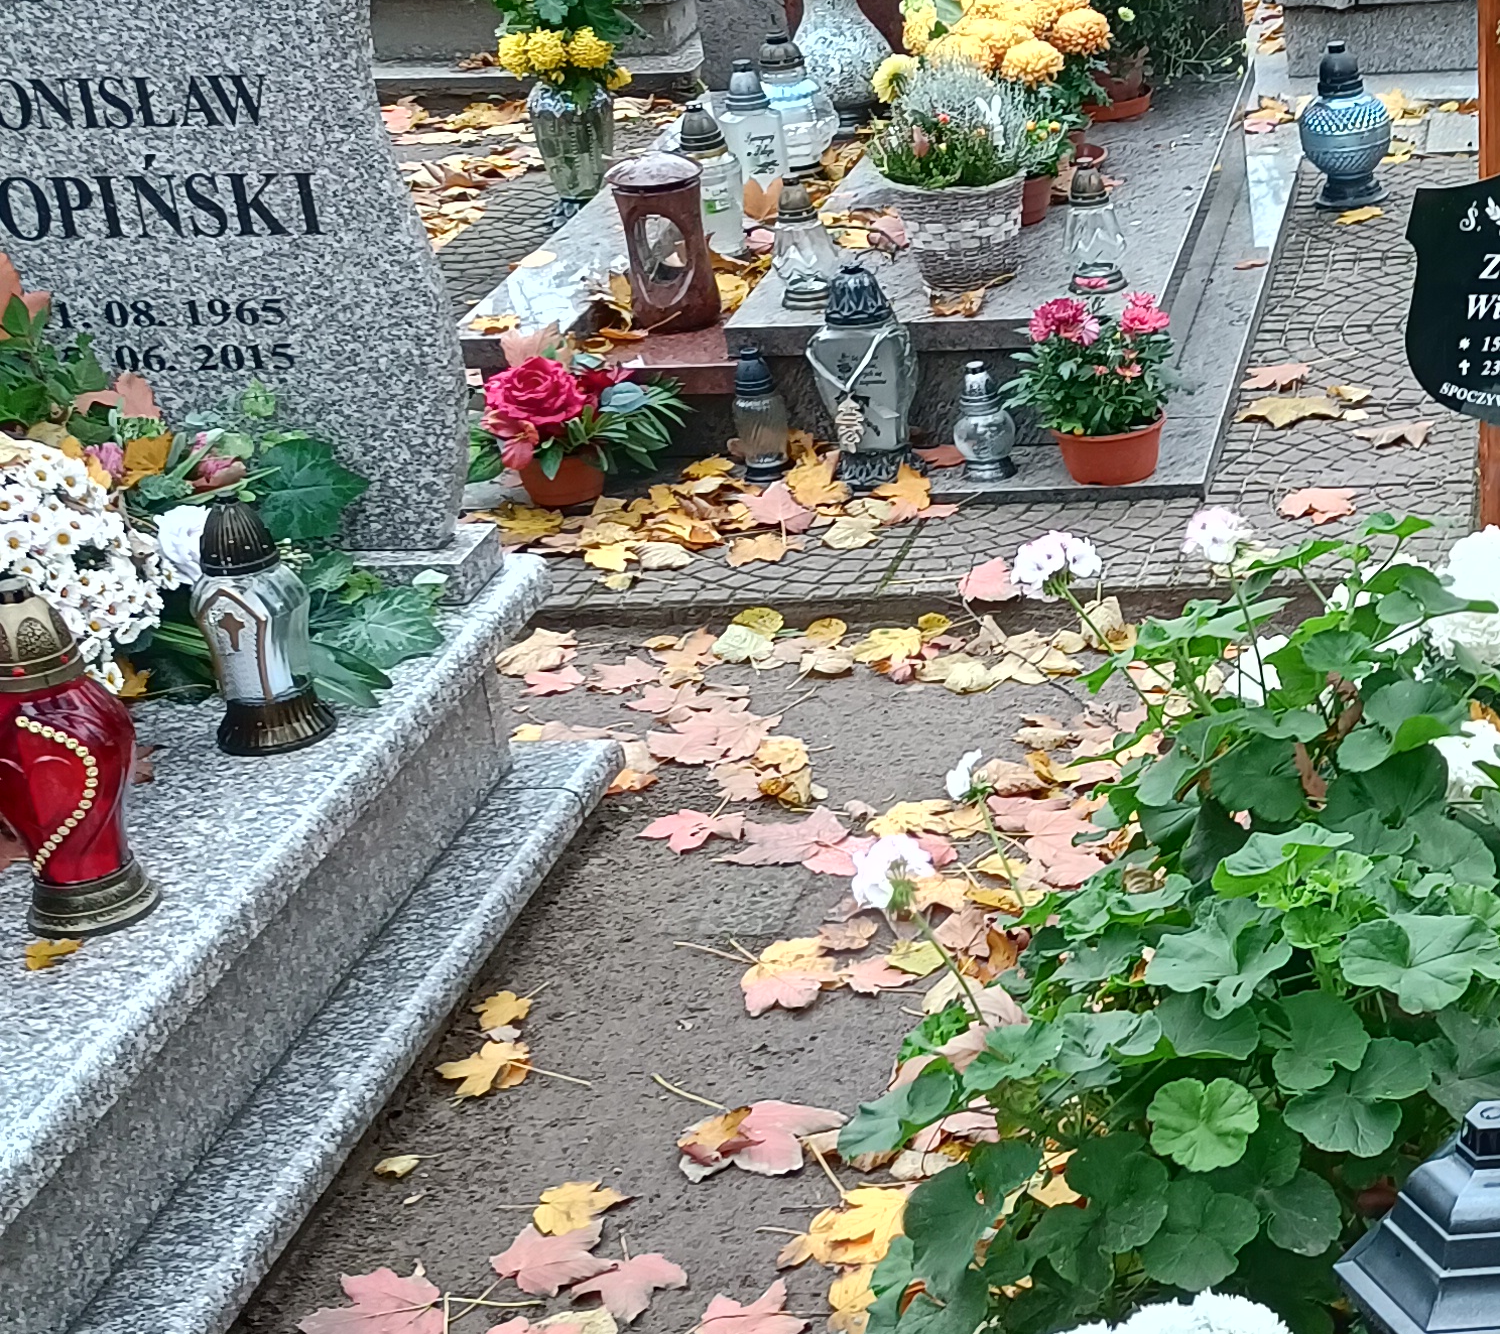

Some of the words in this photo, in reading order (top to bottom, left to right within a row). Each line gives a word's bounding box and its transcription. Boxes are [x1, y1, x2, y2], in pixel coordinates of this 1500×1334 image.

[0, 154, 326, 242] OPIŃSKI
[104, 299, 167, 328] 08.
[182, 297, 287, 327] 1965
[115, 344, 178, 372] 06.
[193, 343, 295, 371] 2015
